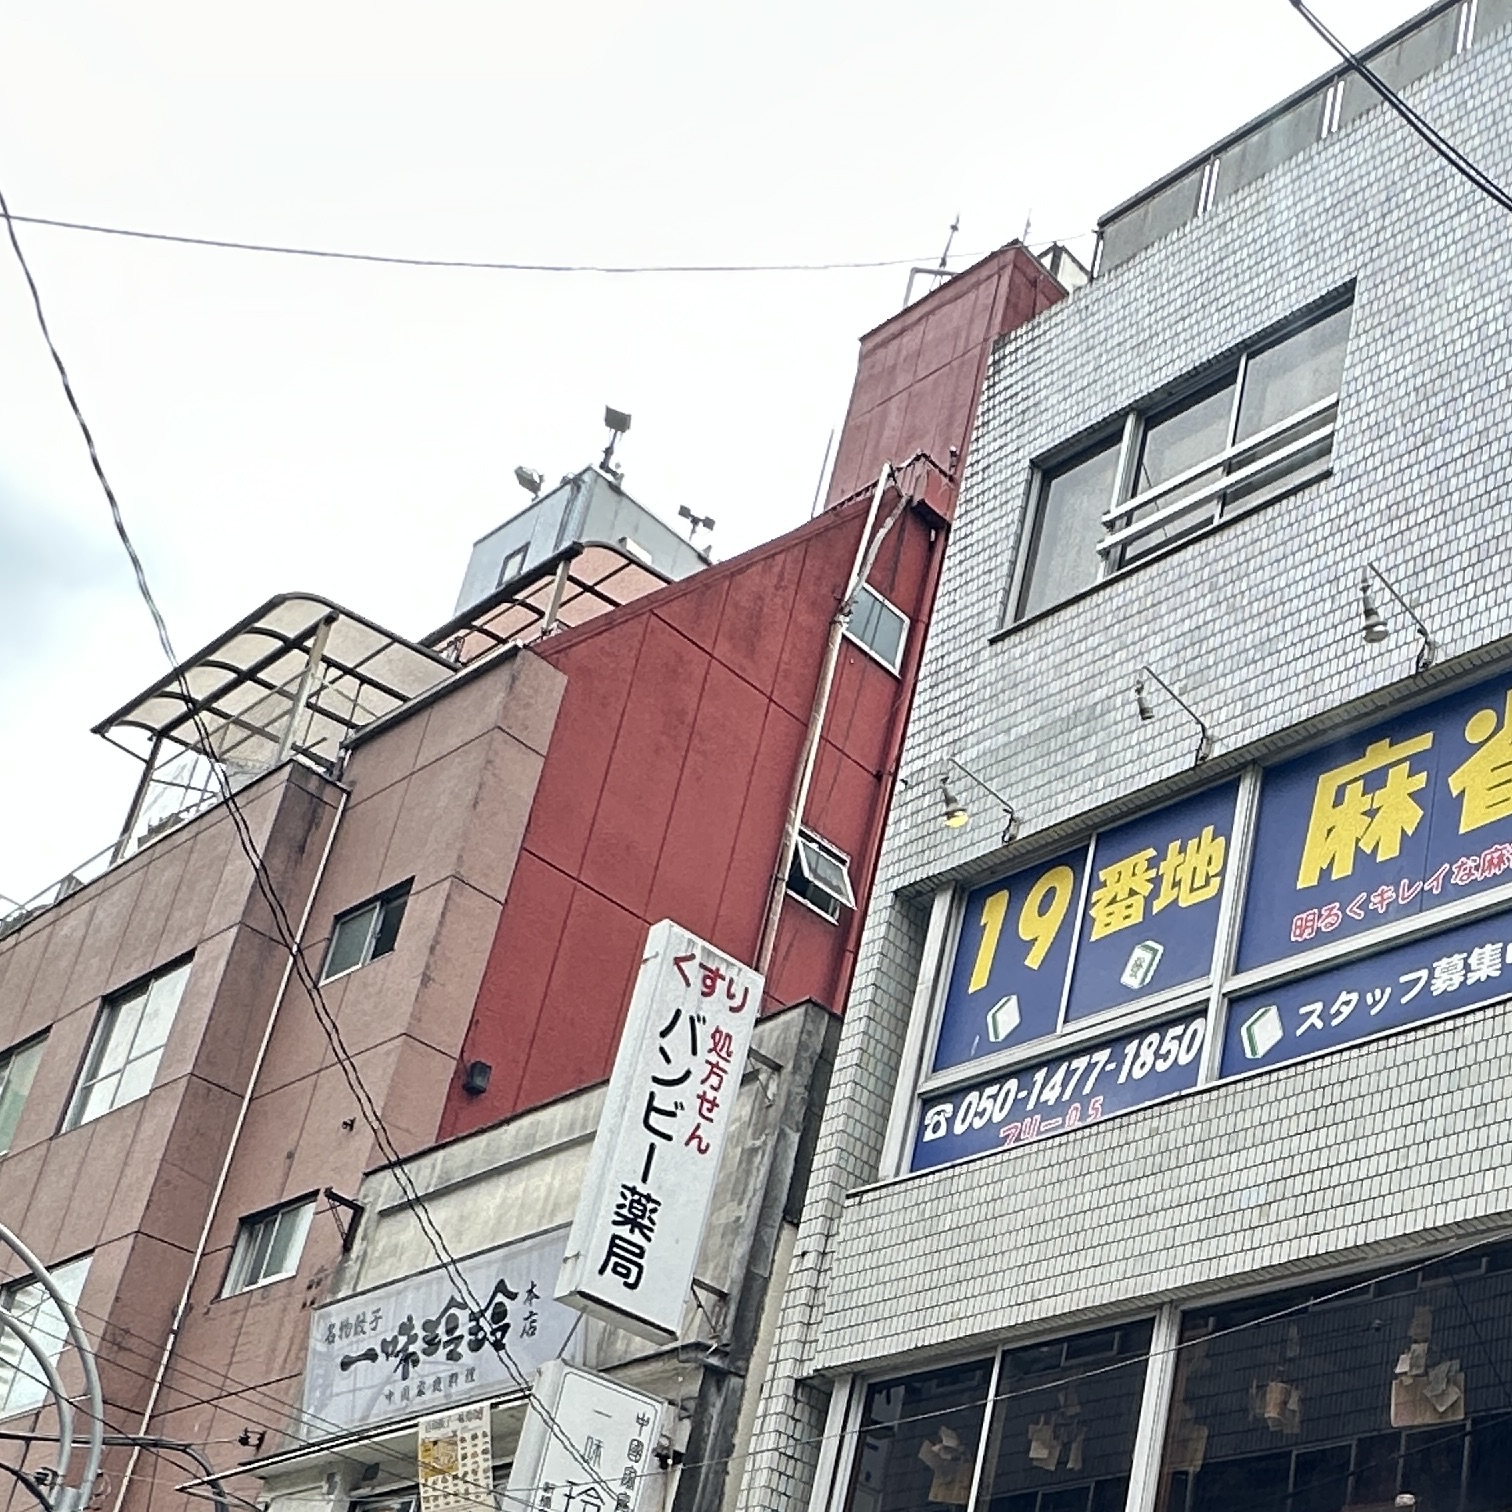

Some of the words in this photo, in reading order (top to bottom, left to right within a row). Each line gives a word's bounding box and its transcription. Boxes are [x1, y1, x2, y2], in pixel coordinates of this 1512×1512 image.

[968, 825, 1226, 994] 19番地
[673, 953, 749, 1013] くすり
[684, 1025, 733, 1154] 処方せん
[953, 1017, 1206, 1135] 050-1477-1850
[598, 1008, 707, 1290] バンビー薬局
